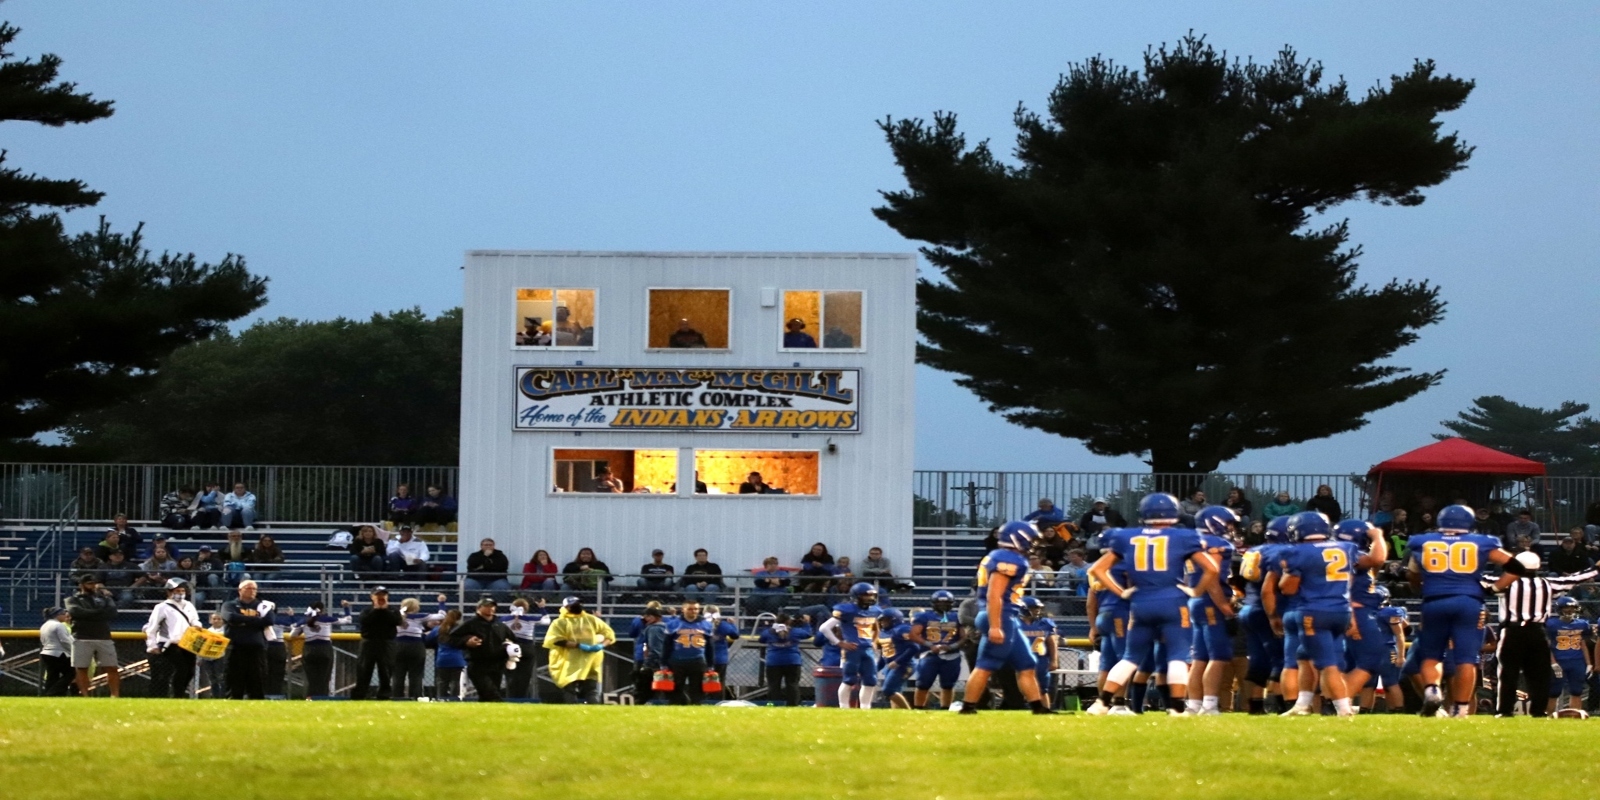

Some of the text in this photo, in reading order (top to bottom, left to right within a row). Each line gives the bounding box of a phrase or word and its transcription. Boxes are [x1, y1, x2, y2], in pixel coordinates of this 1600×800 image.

[519, 368, 624, 401] CARL
[589, 391, 793, 407] ATHLETIC COMPLEX
[519, 404, 856, 428] Home of the INDIANS ARROWS
[1130, 535, 1169, 571] 11
[1323, 548, 1350, 582] 2
[1421, 540, 1478, 573] 60
[603, 693, 635, 705] 50
